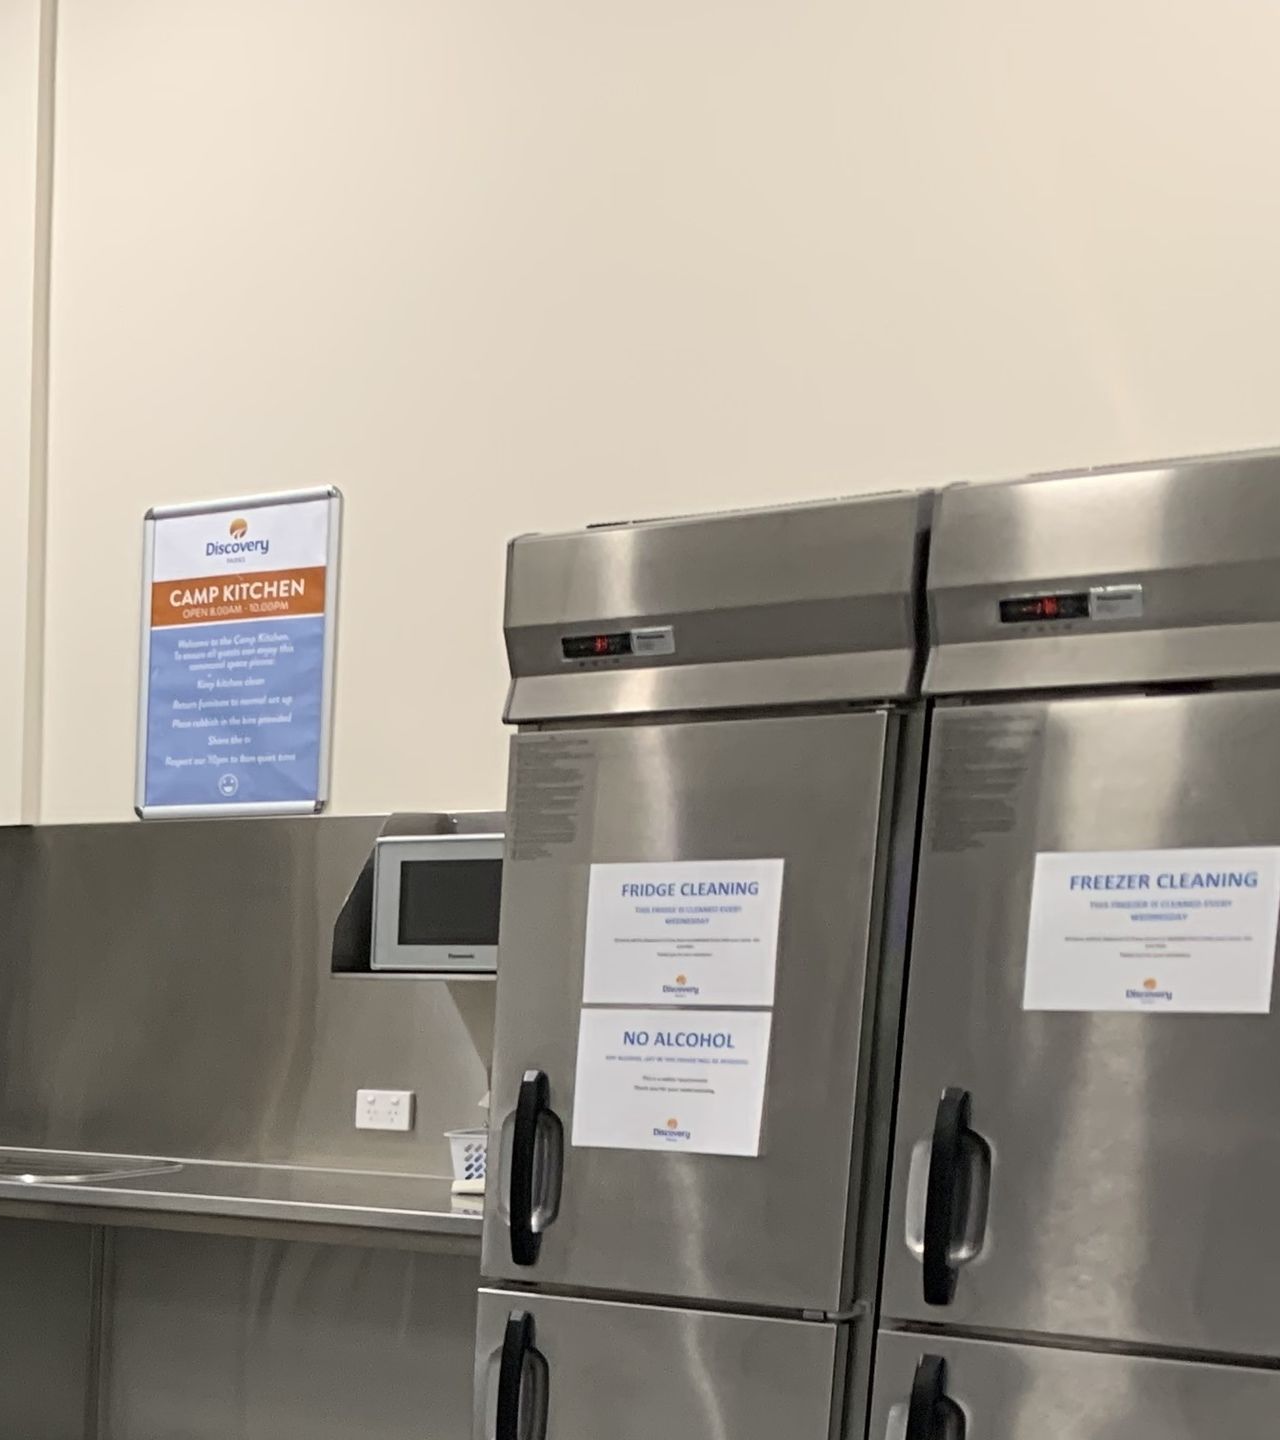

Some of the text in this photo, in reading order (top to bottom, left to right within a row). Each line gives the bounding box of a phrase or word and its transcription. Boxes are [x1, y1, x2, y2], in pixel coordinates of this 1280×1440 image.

[206, 539, 270, 556] Discovery
[169, 578, 305, 607] CAMP KITCHEN
[182, 608, 209, 619] OPEN
[233, 634, 257, 646] Camp
[215, 677, 243, 688] kitchen
[1070, 871, 1259, 891] FREEZER CLEANING
[621, 881, 759, 898] FRIDGE CLEANING
[662, 984, 700, 995] Discovery
[623, 1031, 736, 1049] NO ALCOHOL
[653, 1128, 691, 1139] Discovery
